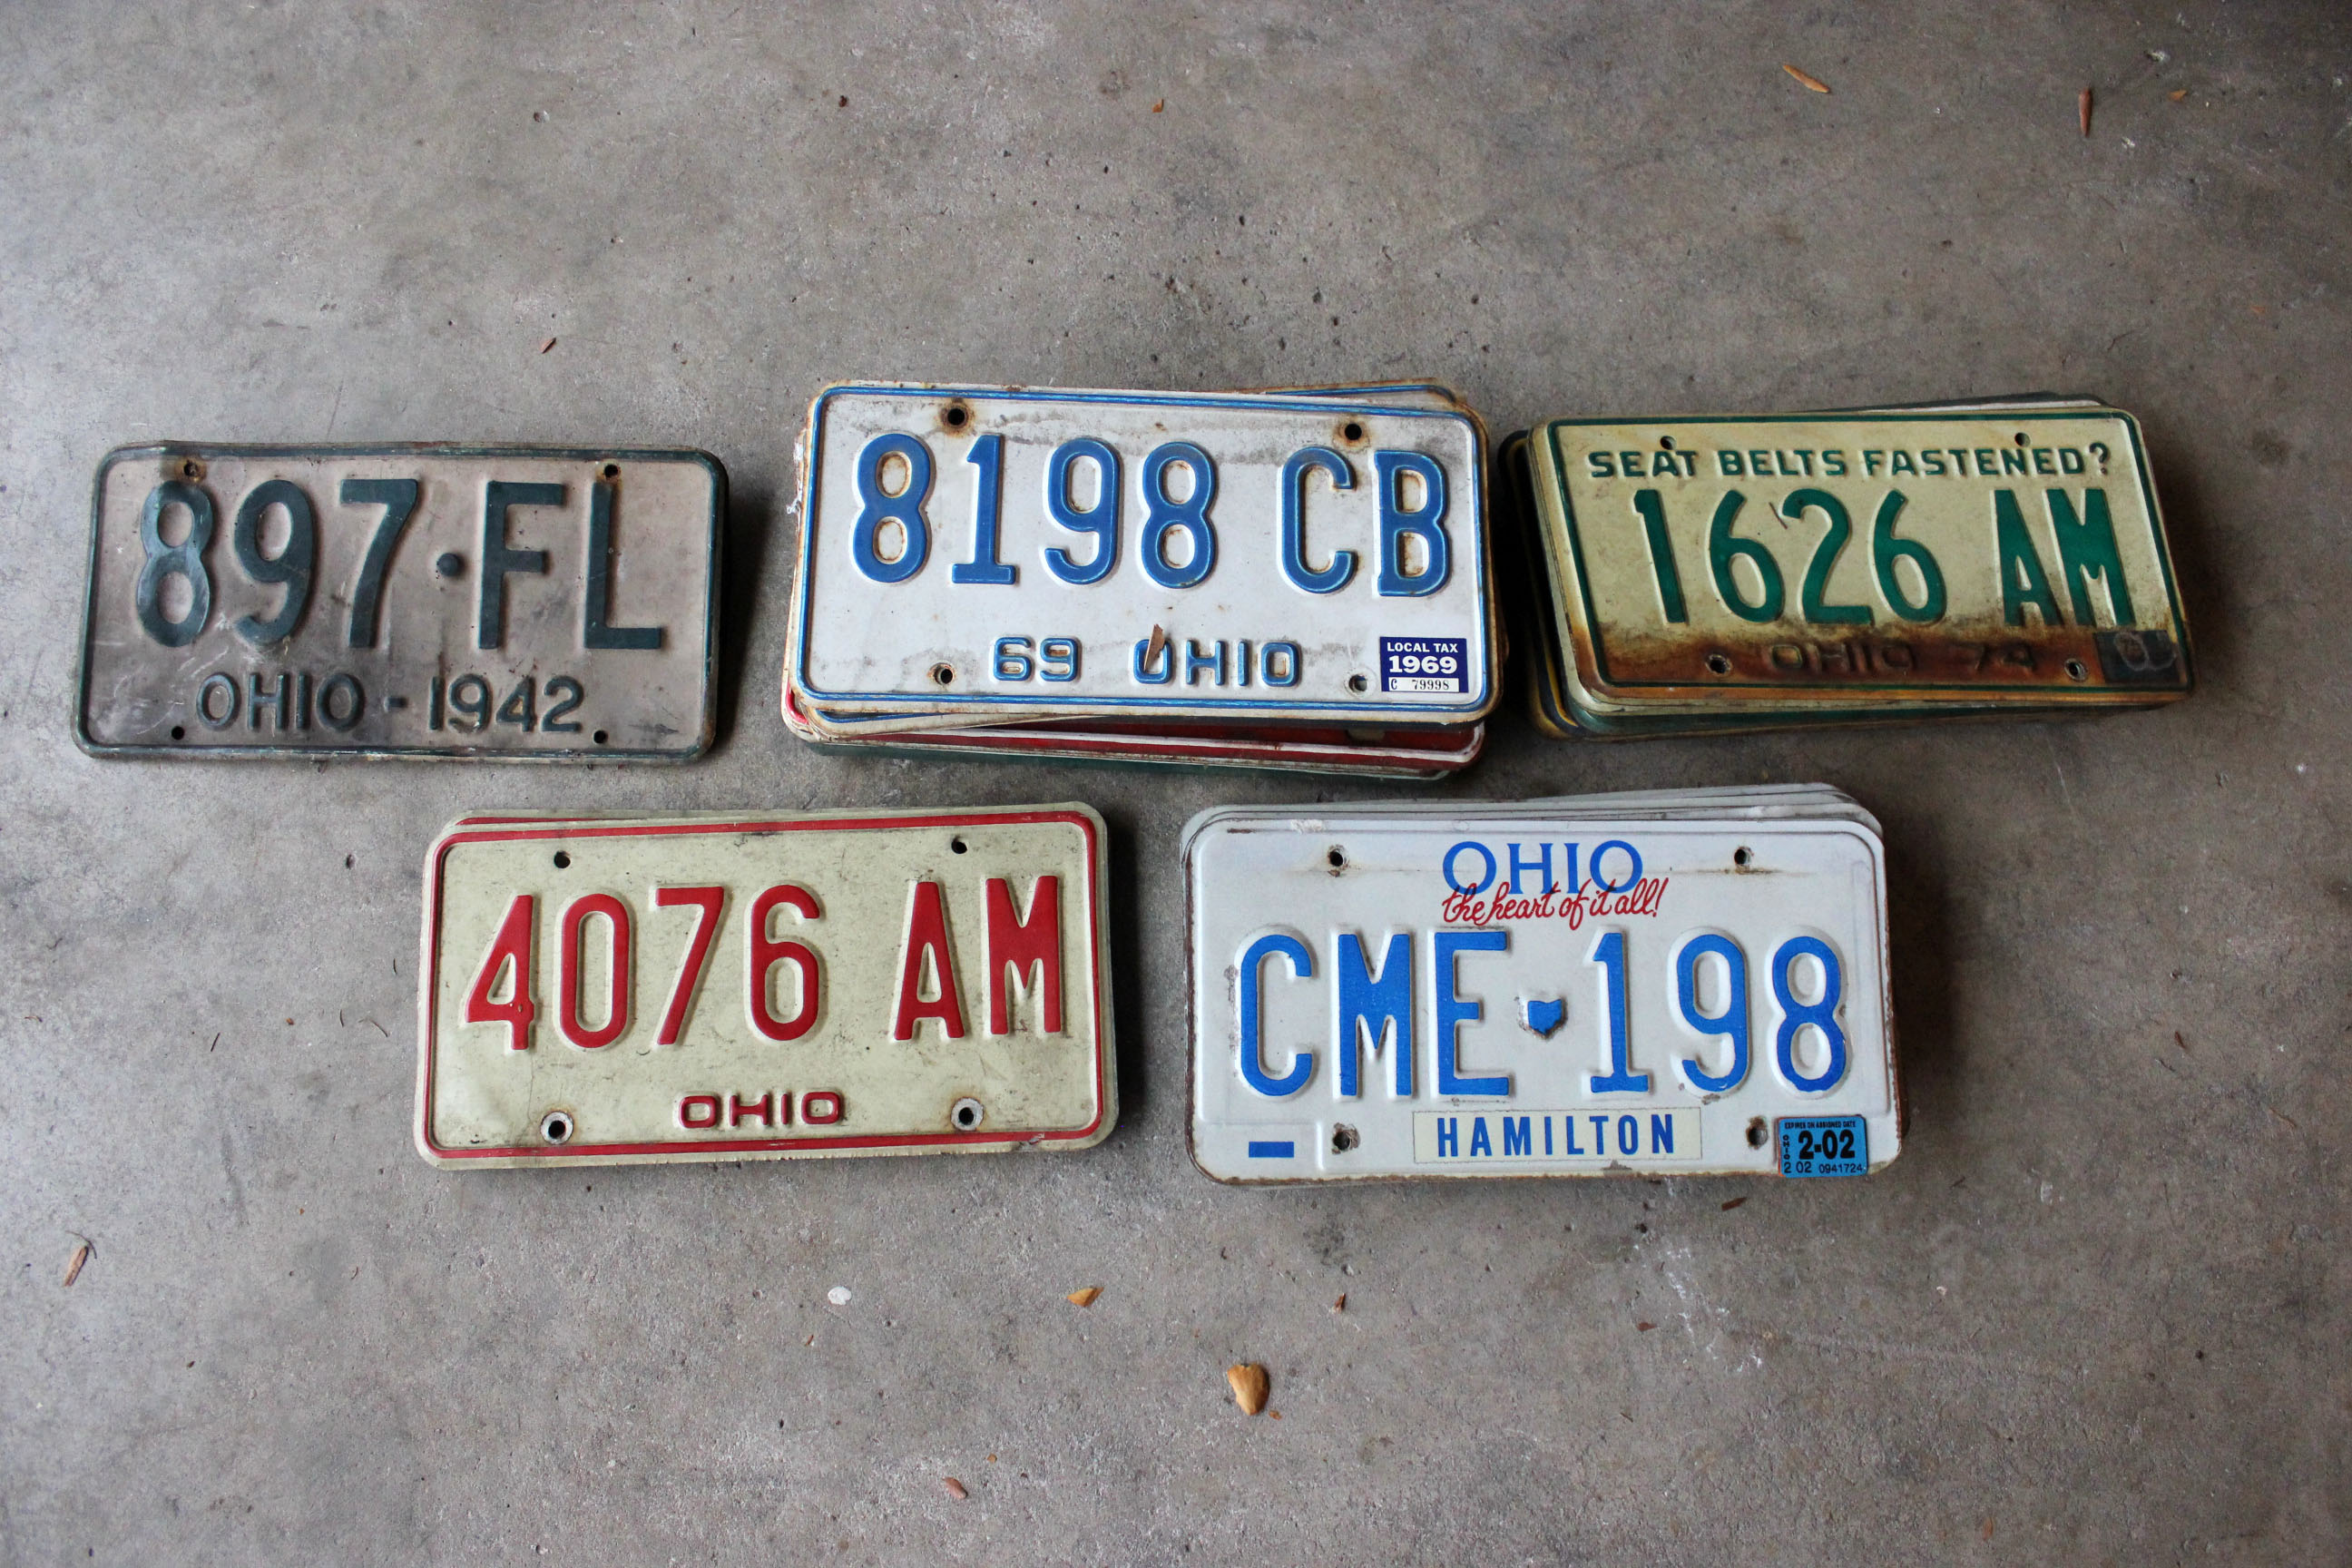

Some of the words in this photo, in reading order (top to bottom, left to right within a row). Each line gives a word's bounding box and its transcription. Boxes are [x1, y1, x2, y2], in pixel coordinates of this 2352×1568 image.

[1588, 451, 1698, 478] SEAT
[1723, 450, 1846, 476] BELTS
[1865, 444, 2112, 476] FASTENED?
[850, 433, 1217, 589] 8198
[1280, 445, 1451, 597] CB
[1632, 488, 1947, 627] 1626
[1992, 488, 2135, 627] AM
[993, 636, 1080, 682] 69
[1133, 638, 1302, 687] OHIO
[1387, 642, 1430, 652] LOCAL
[1433, 642, 1458, 653] TAX
[1388, 654, 1458, 674] 1969
[1770, 642, 1915, 672] OHIO
[196, 673, 366, 731] OHIO
[427, 677, 585, 733] 1942
[1390, 678, 1398, 691] C
[1442, 839, 1643, 895] OHIO
[1441, 882, 1491, 926] the
[1485, 880, 1561, 925] heart
[1558, 877, 1592, 931] of
[1589, 877, 1617, 916] it
[1613, 877, 1670, 918] all!
[465, 884, 820, 1050] 4076
[892, 875, 1062, 1041] AM
[1240, 931, 1510, 1096] CME
[1590, 931, 1847, 1093] 198
[678, 1091, 841, 1130] OHIO
[1436, 1113, 1674, 1158] HAMILTON
[1798, 1130, 1856, 1161] 2-02
[1783, 1161, 1792, 1173] 2
[1795, 1161, 1813, 1173] 02
[1818, 1163, 1863, 1174] 0941724
